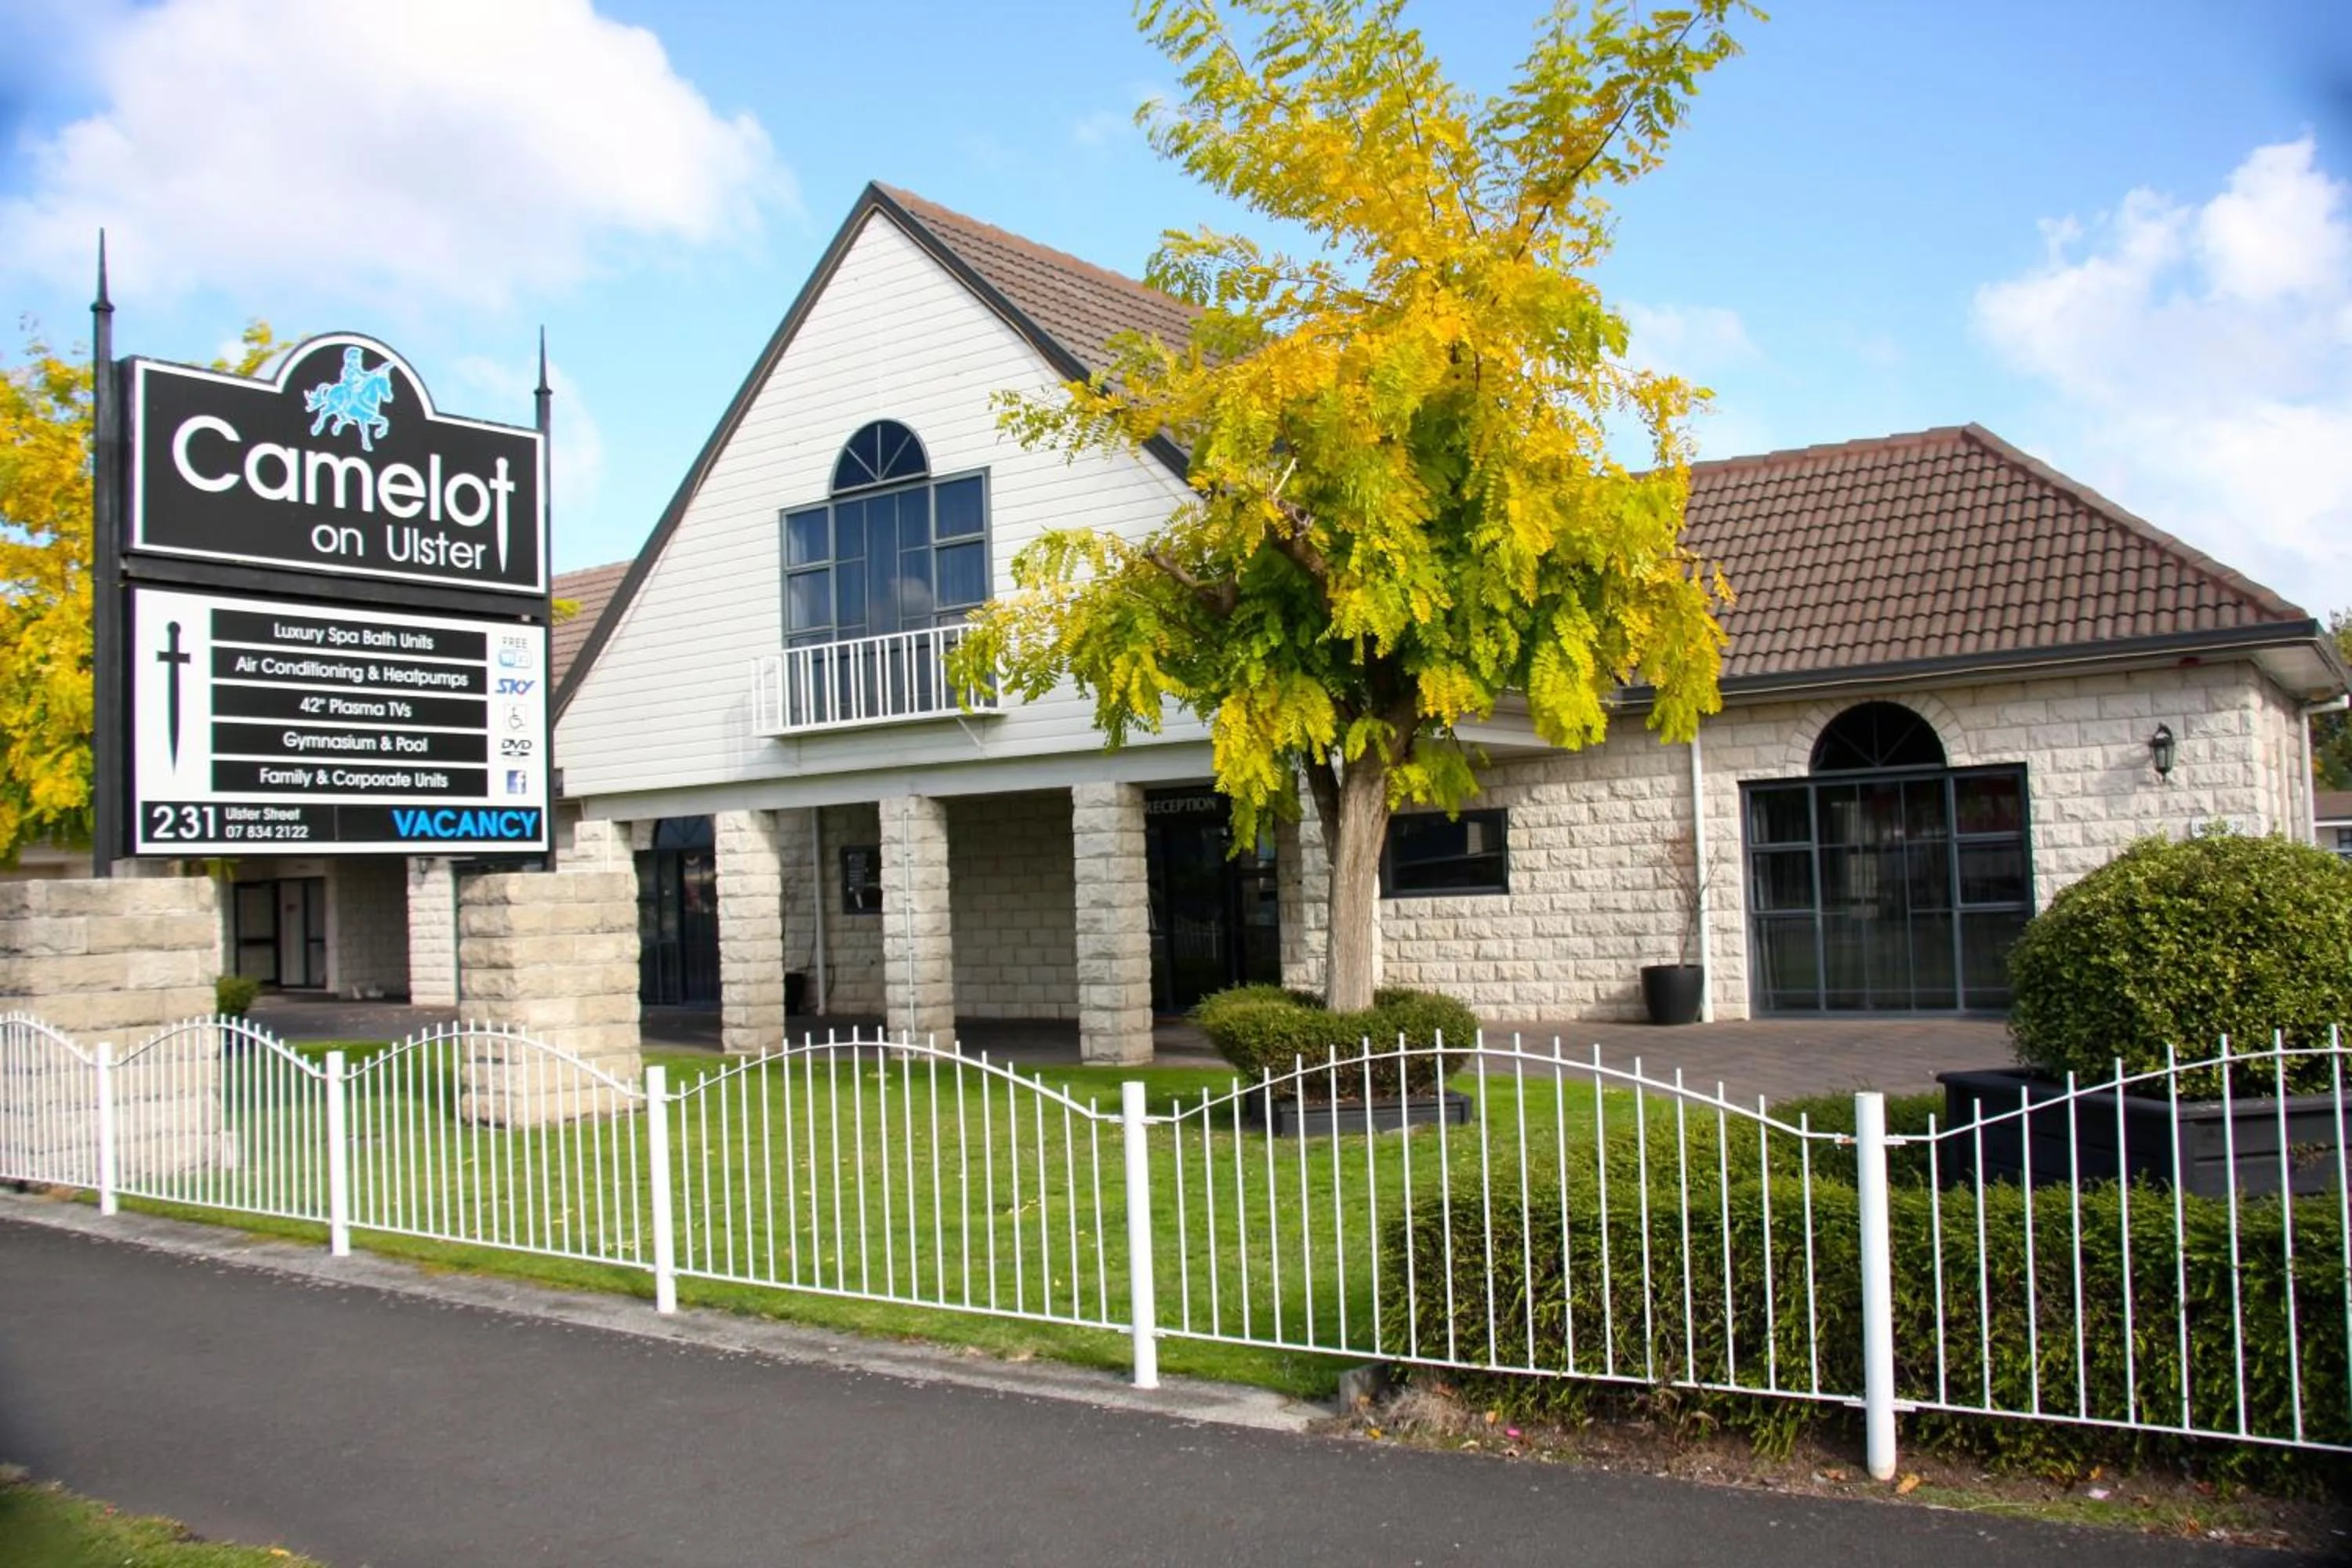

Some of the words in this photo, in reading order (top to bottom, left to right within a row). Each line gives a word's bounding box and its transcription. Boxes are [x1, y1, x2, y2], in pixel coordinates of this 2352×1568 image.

[172, 415, 514, 574] Camelot
[311, 524, 364, 556] on
[385, 524, 486, 571] Ulster
[273, 622, 324, 644] Luxury
[327, 627, 359, 645] Spa
[363, 630, 397, 646] Bath
[400, 633, 434, 649] Units
[235, 656, 258, 672] Air
[260, 657, 365, 682] Conditioning
[368, 666, 379, 681] &
[383, 666, 468, 688] Heatpumps
[329, 699, 385, 716] Plasma
[388, 702, 412, 717] TVs
[283, 731, 376, 750] Gymnasium
[380, 736, 393, 751] &
[396, 737, 427, 752] Pool
[502, 739, 532, 750] DVD
[260, 768, 312, 787] Family
[316, 769, 329, 785] &
[332, 770, 412, 789] Corporate
[416, 773, 448, 787] Units
[153, 805, 215, 839] 231
[226, 808, 259, 820] Ulster
[263, 808, 300, 820] Street
[393, 810, 539, 838] VACANCY
[226, 826, 243, 838] 07
[247, 826, 272, 838] 834
[277, 826, 308, 838] 2122
